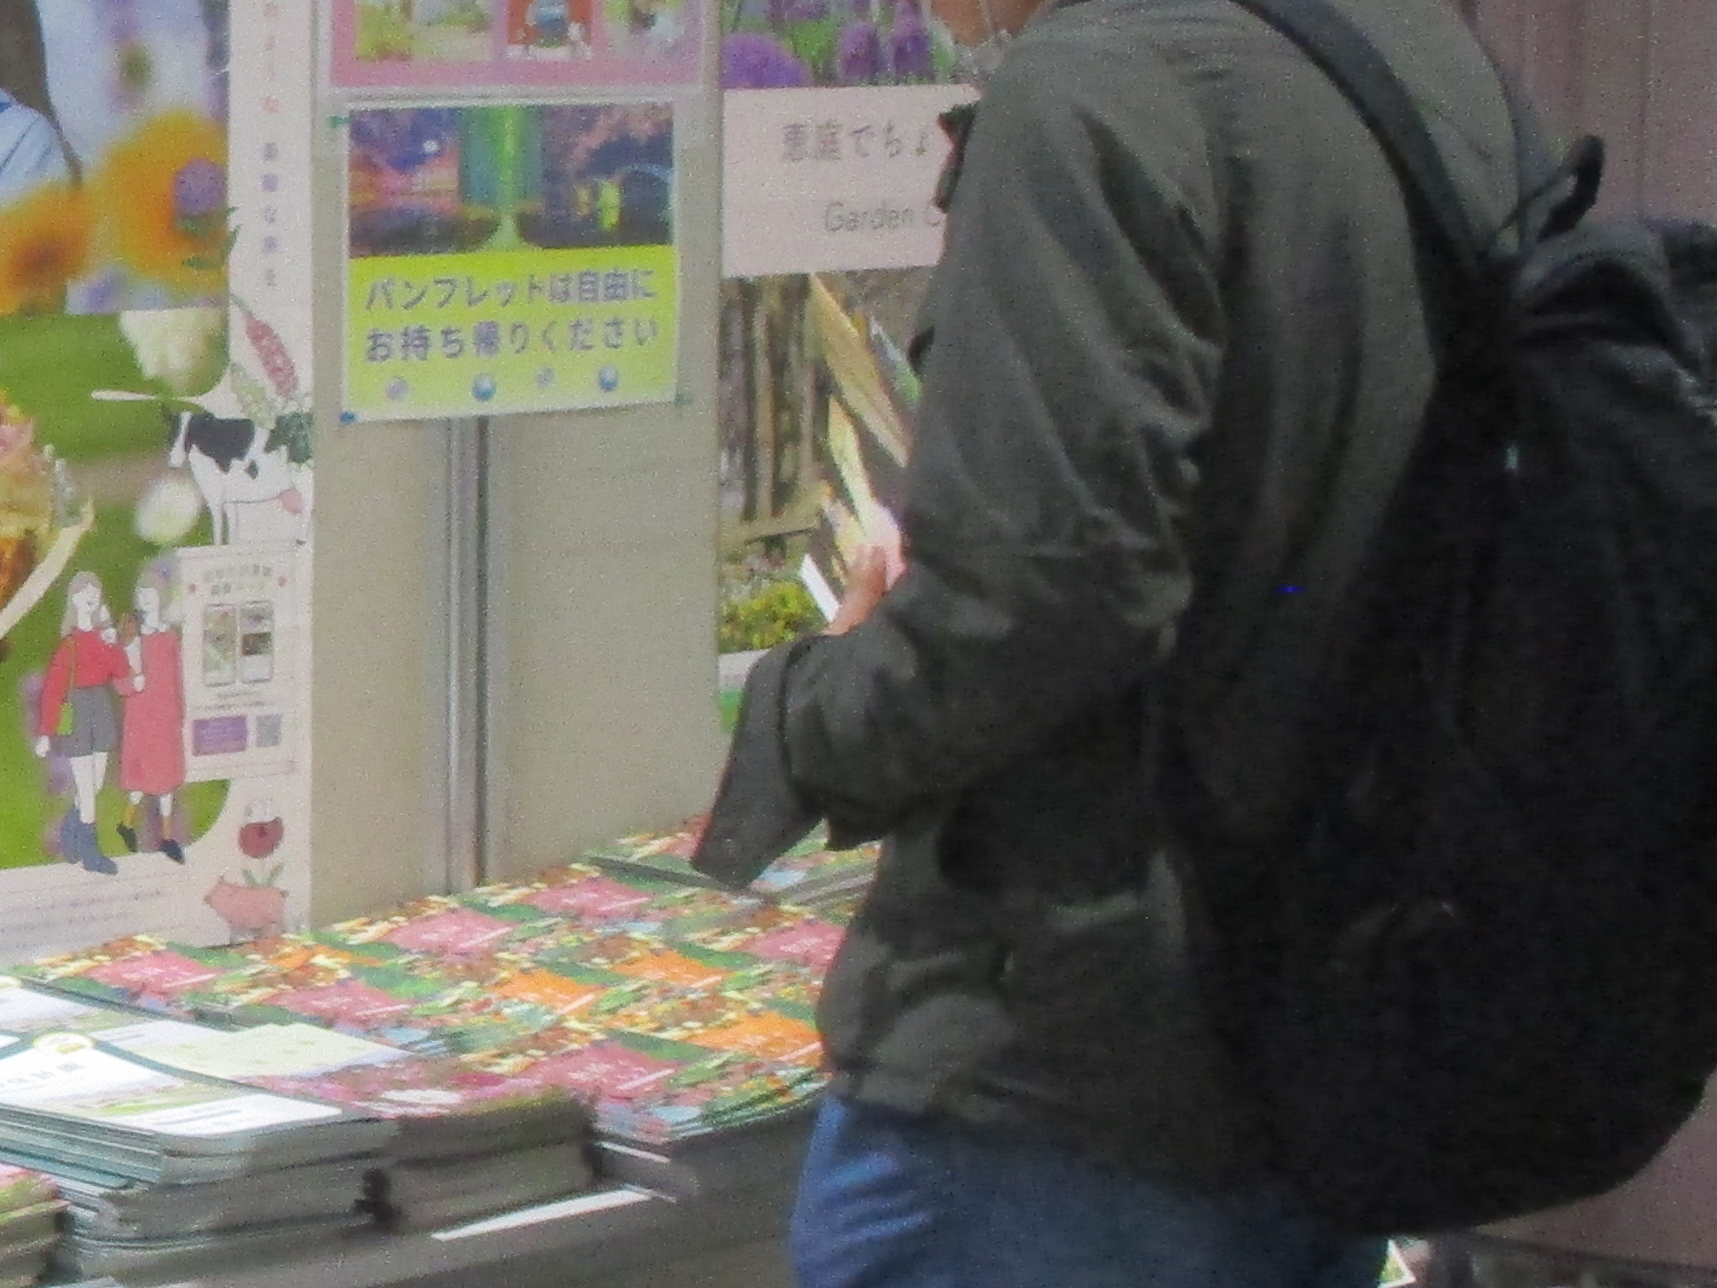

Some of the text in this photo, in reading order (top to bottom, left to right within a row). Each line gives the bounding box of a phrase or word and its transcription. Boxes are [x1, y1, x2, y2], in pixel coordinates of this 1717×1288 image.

[825, 199, 913, 232] Garden
[366, 266, 656, 312] パンフレットは自由に
[366, 317, 658, 364] お持ち帰りください
